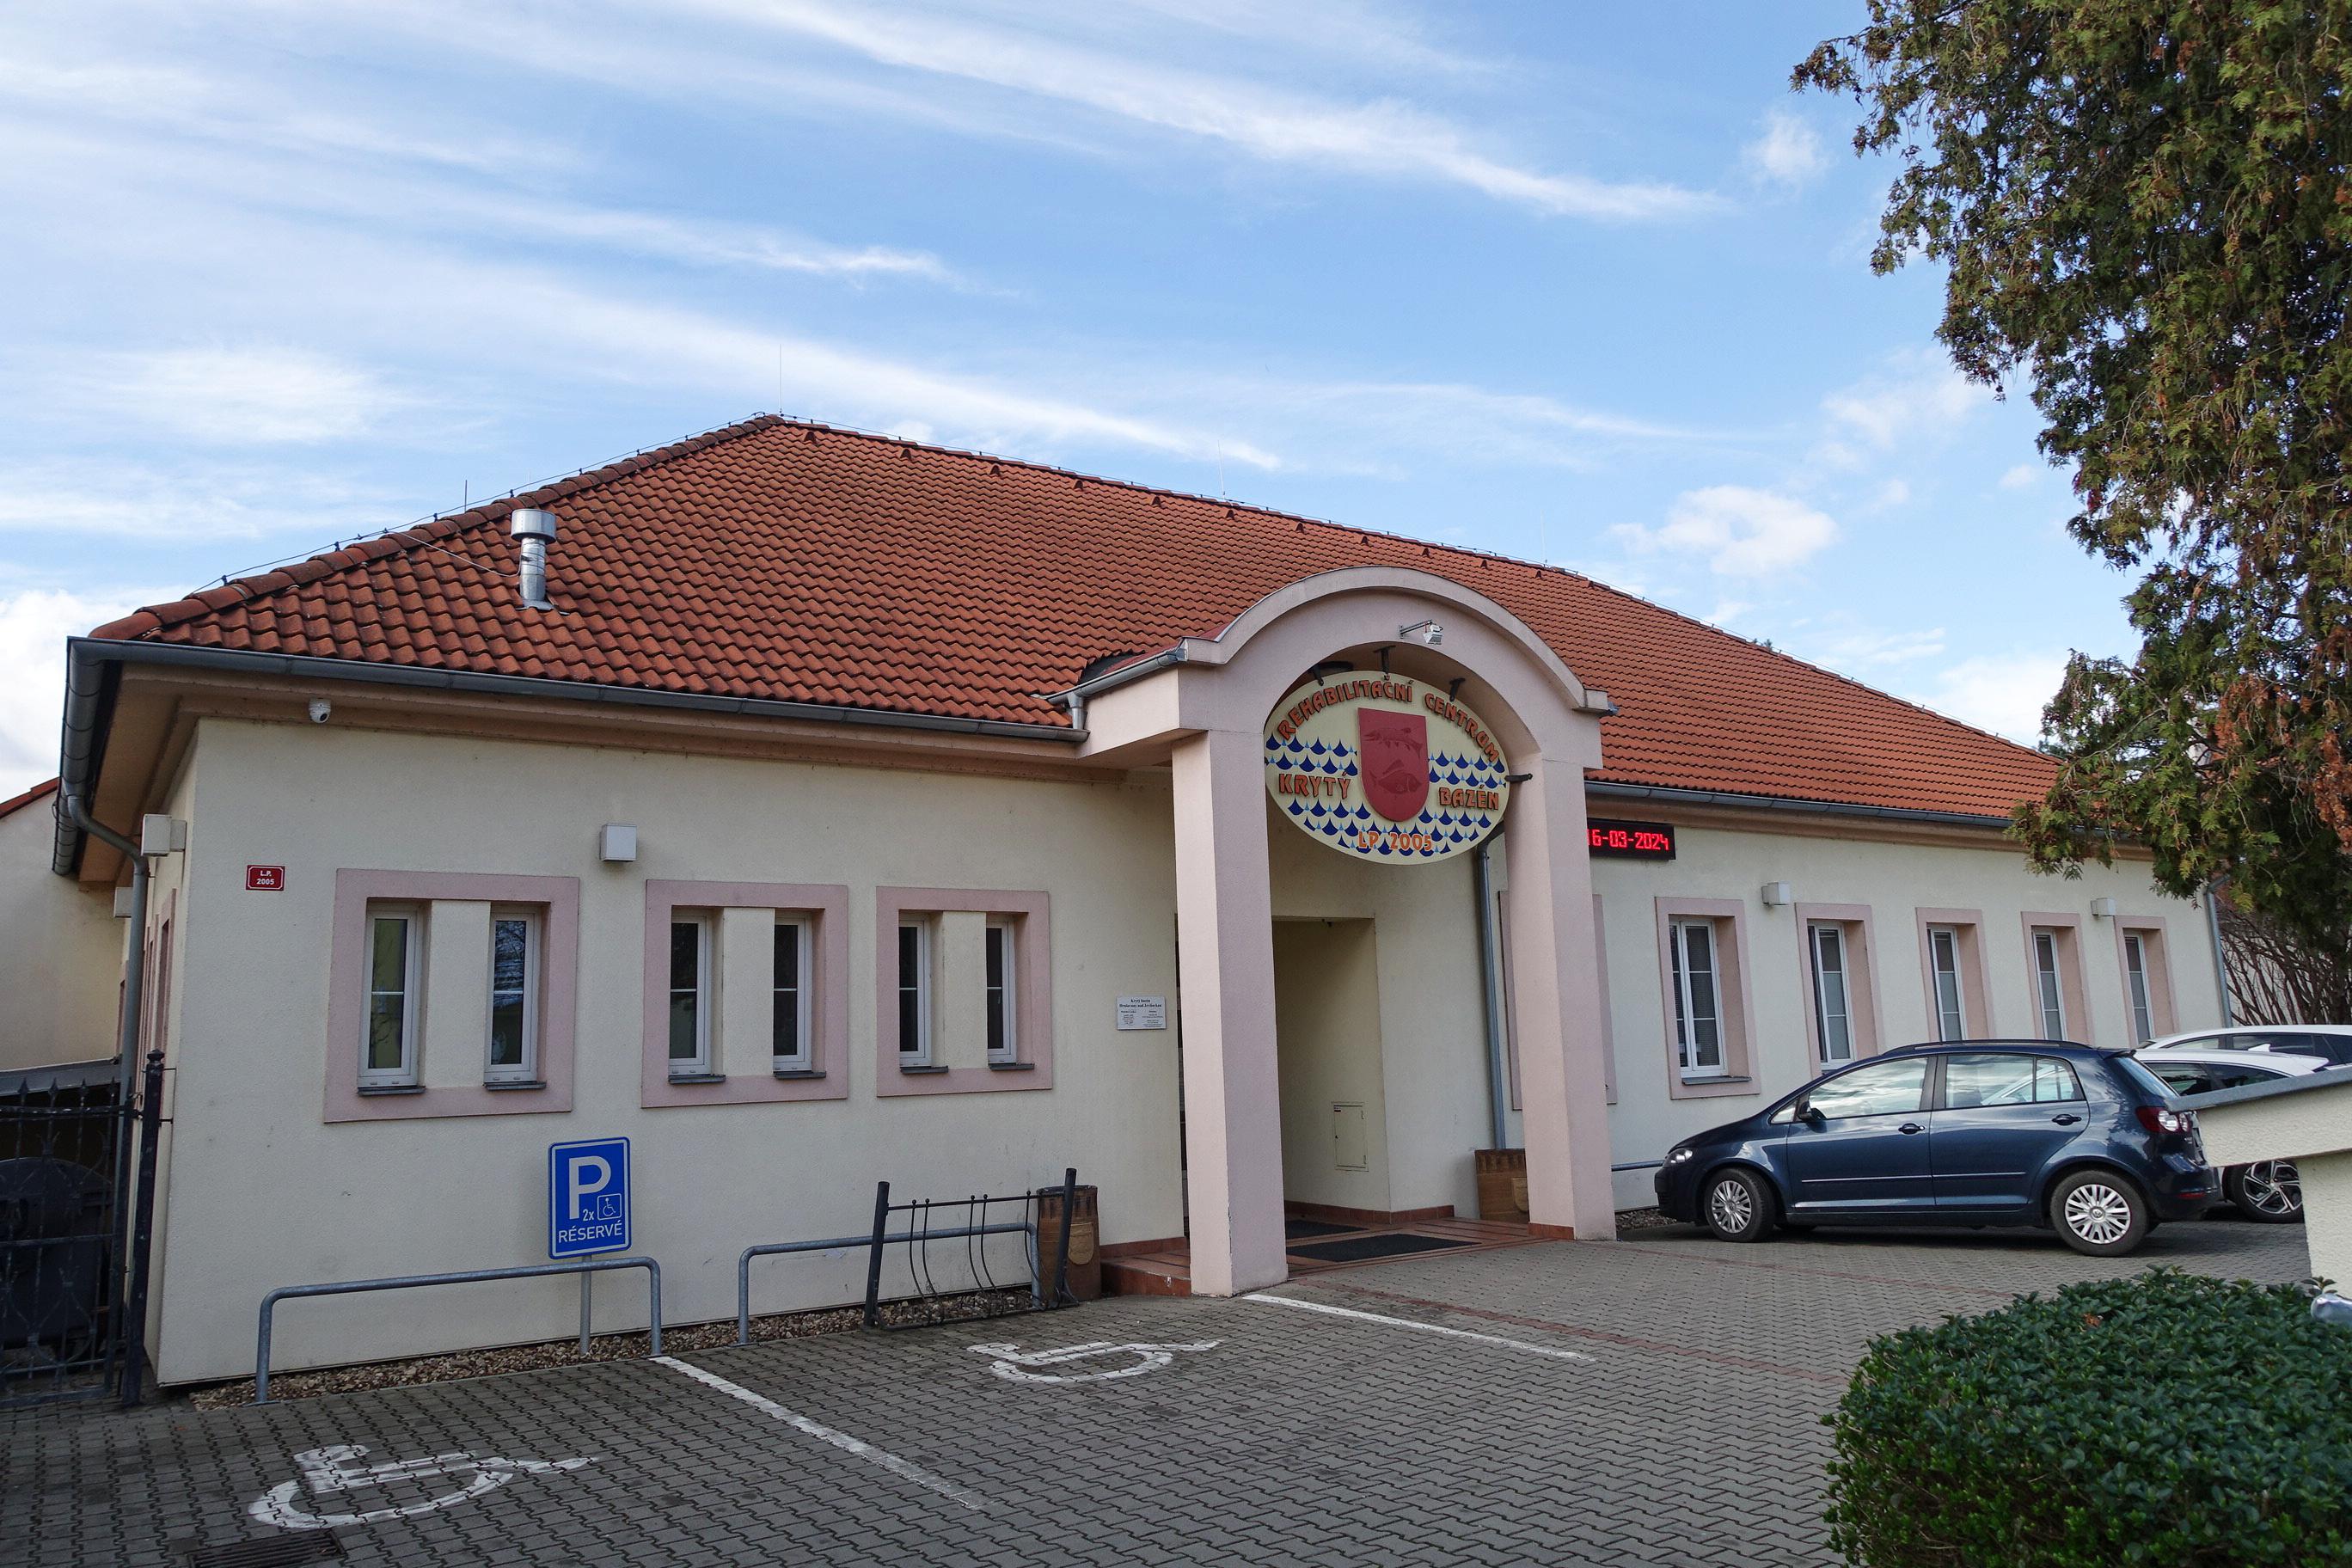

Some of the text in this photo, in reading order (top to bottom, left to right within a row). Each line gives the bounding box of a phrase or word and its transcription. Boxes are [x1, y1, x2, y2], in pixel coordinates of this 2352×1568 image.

[1277, 675, 1499, 763] REHABILITAČNÍ CENTRUM
[1278, 772, 1499, 811] KRYTÝ BAZÉN
[1358, 830, 1432, 850] LP 2005
[569, 1155, 611, 1220] P
[583, 1209, 594, 1222] 2x
[558, 1220, 623, 1243] RÉSERVÉ
